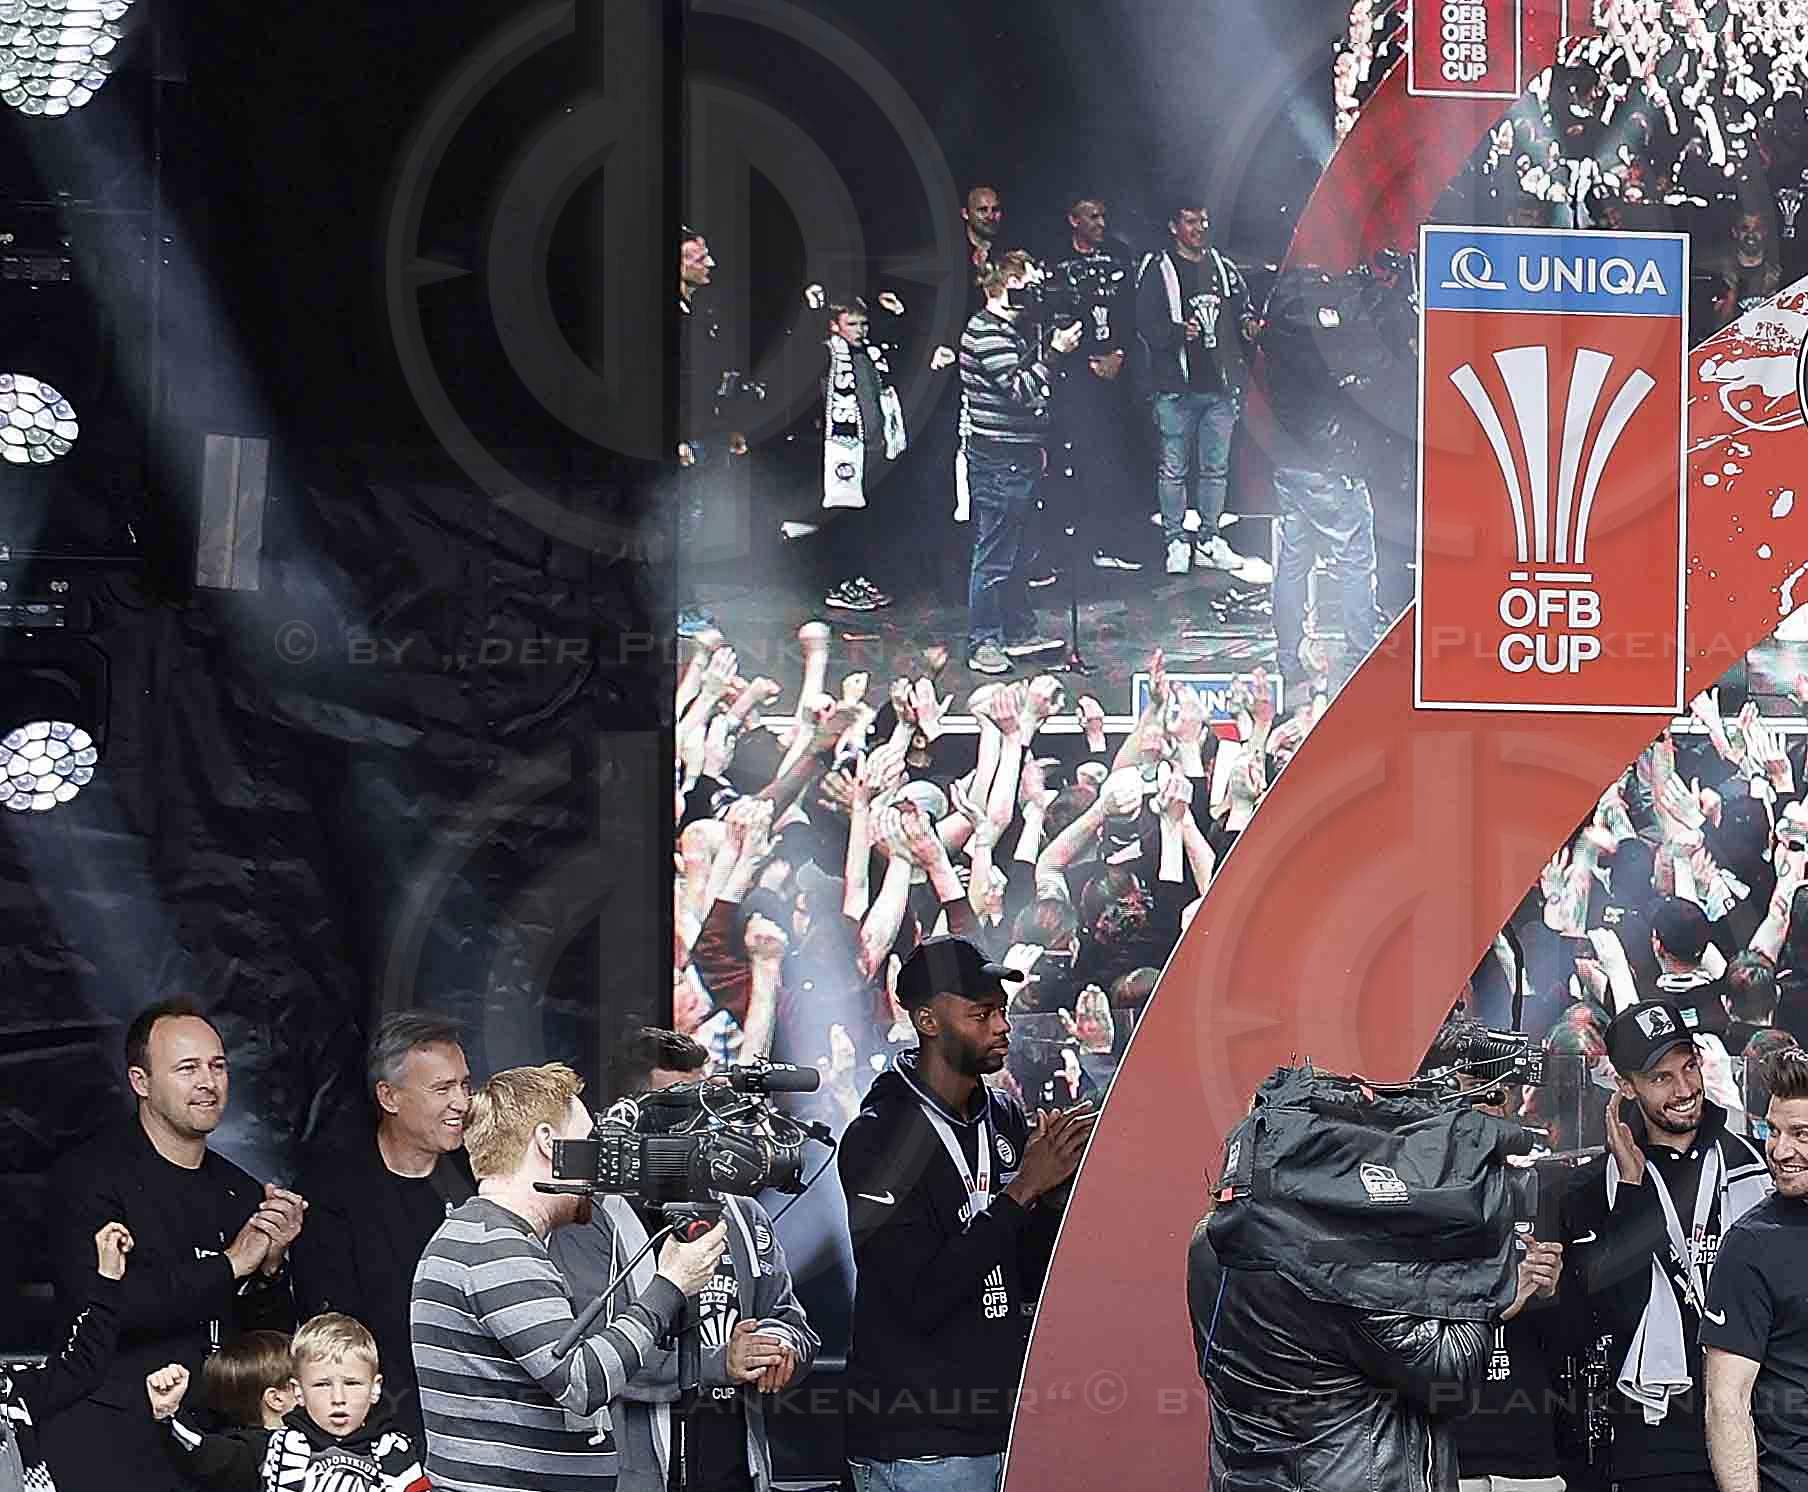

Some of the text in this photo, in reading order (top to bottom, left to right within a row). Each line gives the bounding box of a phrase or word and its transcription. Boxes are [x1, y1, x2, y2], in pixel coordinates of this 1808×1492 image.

[1520, 256, 1667, 297] UNIQA
[1500, 634, 1600, 674] CUP
[984, 1305, 1008, 1319] CUP
[1488, 1355, 1510, 1368] FB
[712, 1387, 735, 1400] CUP
